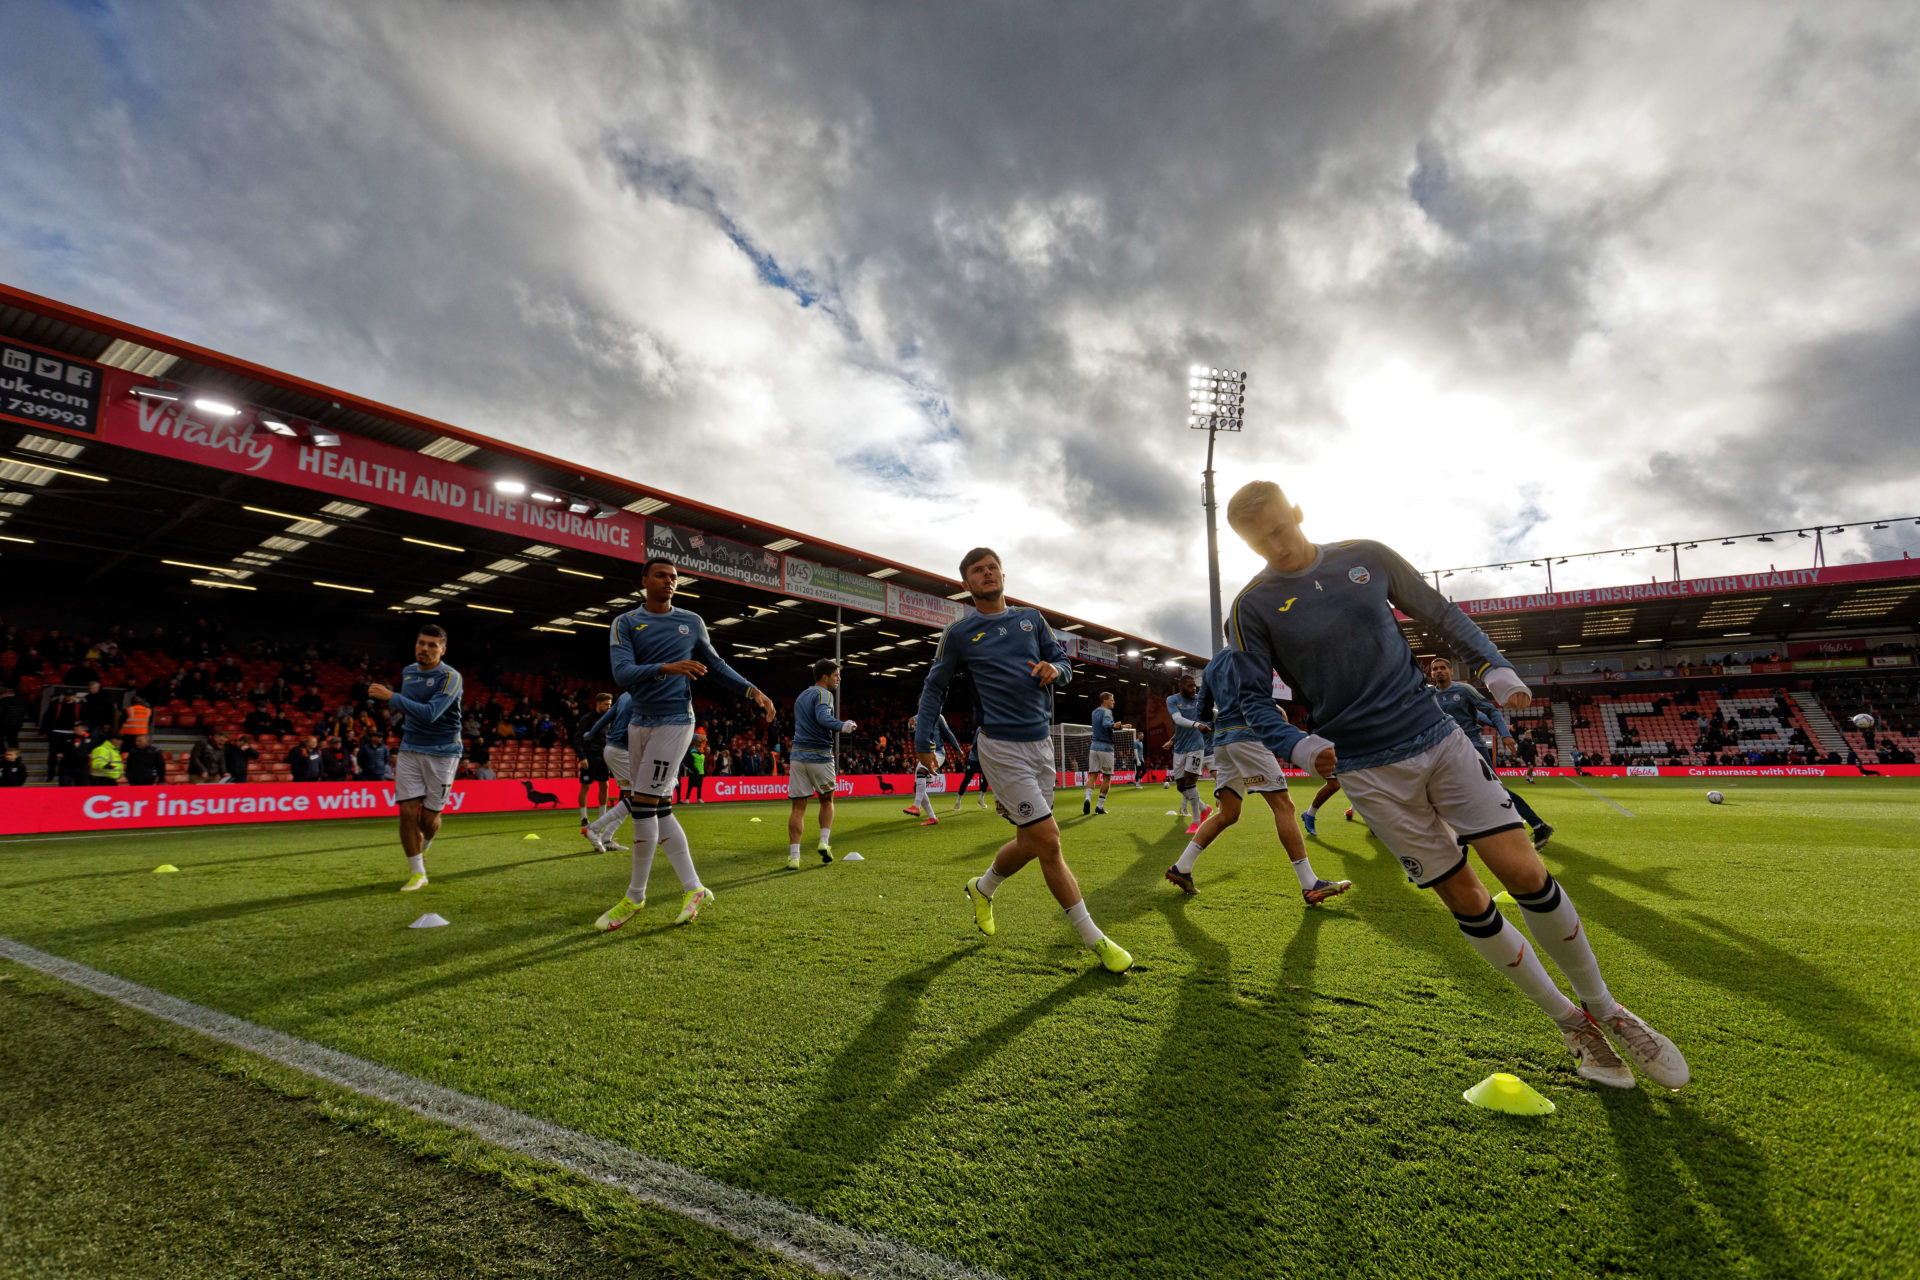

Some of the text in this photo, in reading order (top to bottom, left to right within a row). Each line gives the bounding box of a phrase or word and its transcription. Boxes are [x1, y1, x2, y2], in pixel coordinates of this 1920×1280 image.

[7, 398, 87, 427] 739993
[138, 396, 273, 471] Vitality
[299, 446, 630, 548] HEALTH AND LIFE INSURANCE
[646, 547, 780, 587] www.dwphousing.co.uk
[813, 567, 838, 581] WASTE
[839, 573, 884, 592] MANAGEMENT
[898, 589, 924, 607] Kevin
[1314, 580, 1324, 591] 4
[1469, 569, 1821, 612] HEALTH AND LIFE INSURANCE WITH VITALITY
[652, 760, 670, 782] 11
[1499, 768, 1518, 777] with
[1688, 767, 1826, 777] Car insurance with Vitality
[715, 781, 736, 795] Car
[83, 795, 147, 819] Car
[156, 790, 310, 816] insurance
[317, 788, 376, 810] with
